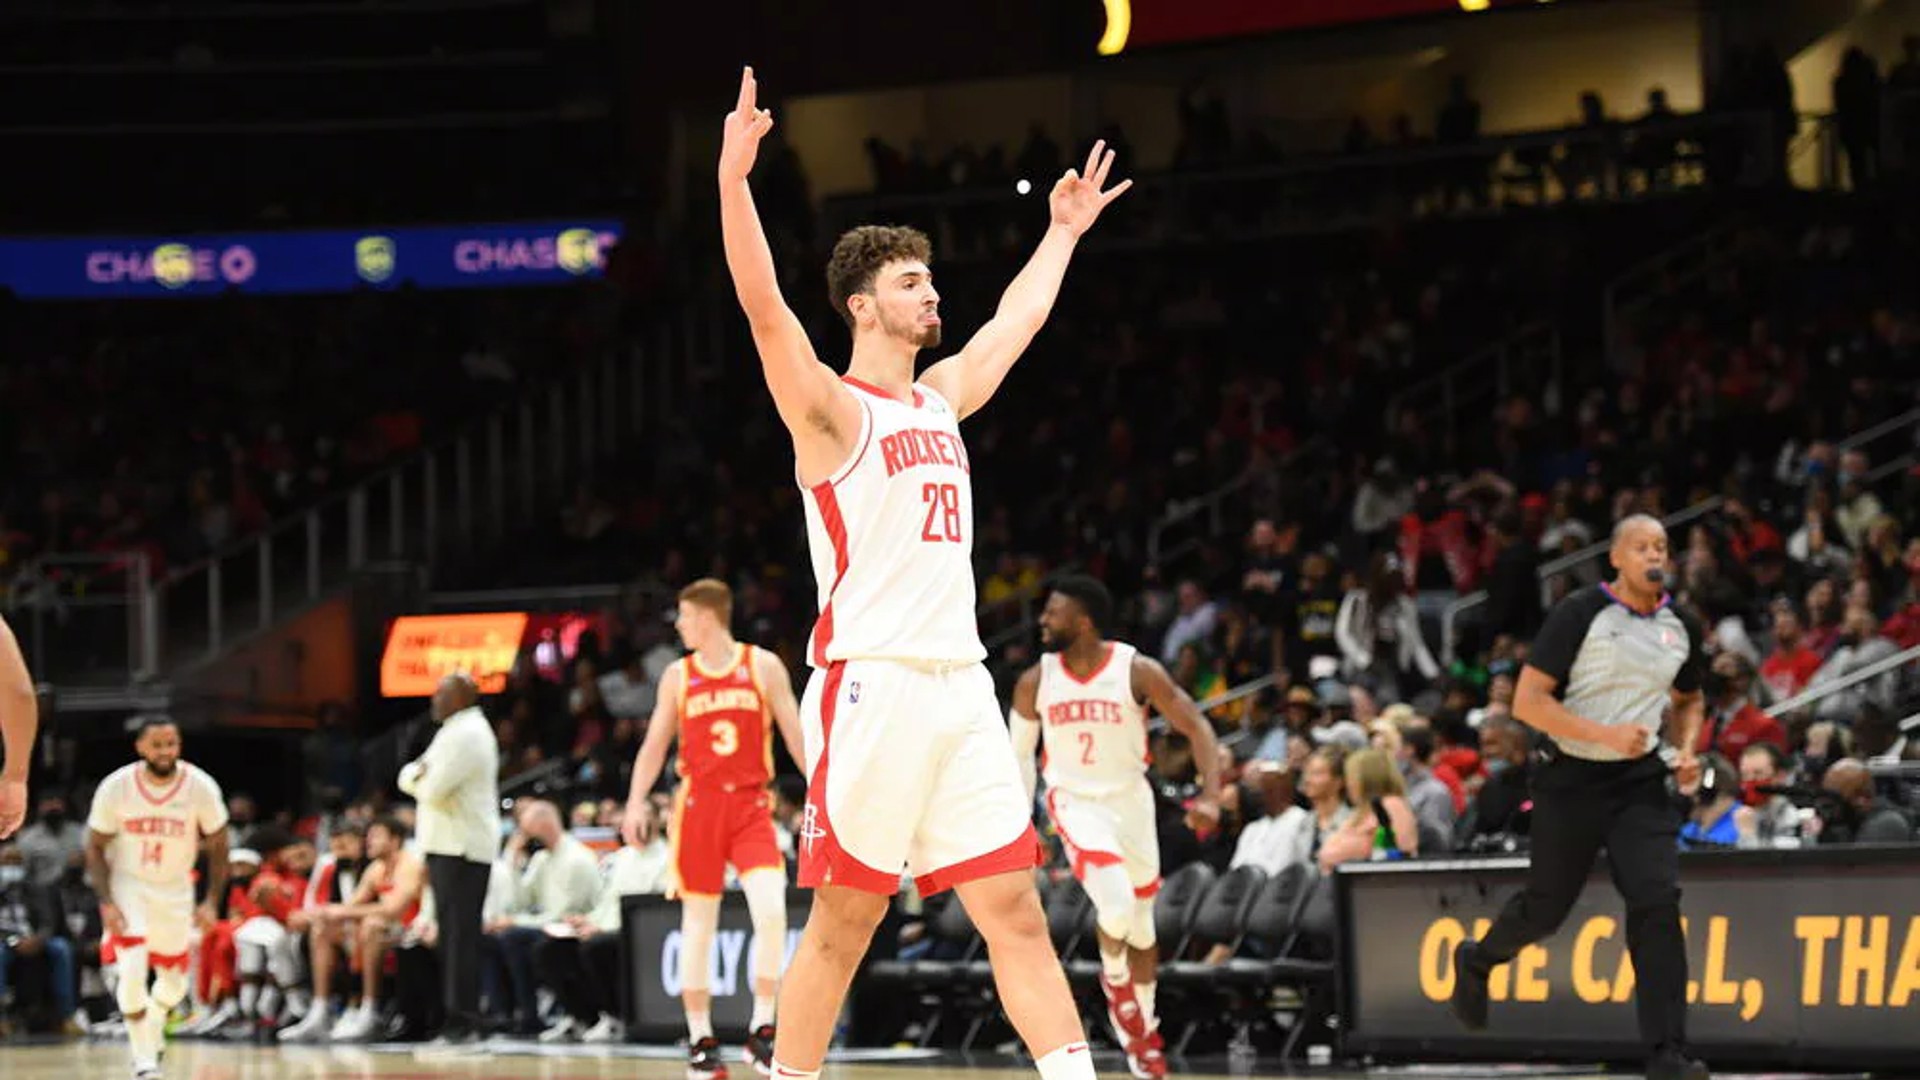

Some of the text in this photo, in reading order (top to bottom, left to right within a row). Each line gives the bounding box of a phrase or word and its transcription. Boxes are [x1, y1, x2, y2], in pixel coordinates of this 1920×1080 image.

[87, 251, 215, 282] CHAE
[454, 237, 576, 272] CHAS
[922, 482, 962, 542] 28
[686, 688, 760, 718] ATLANTA
[1048, 699, 1122, 726] ROCKETS
[710, 719, 739, 756] 3
[1078, 731, 1097, 765] 2
[142, 840, 162, 865] 14
[661, 930, 746, 996] OLY
